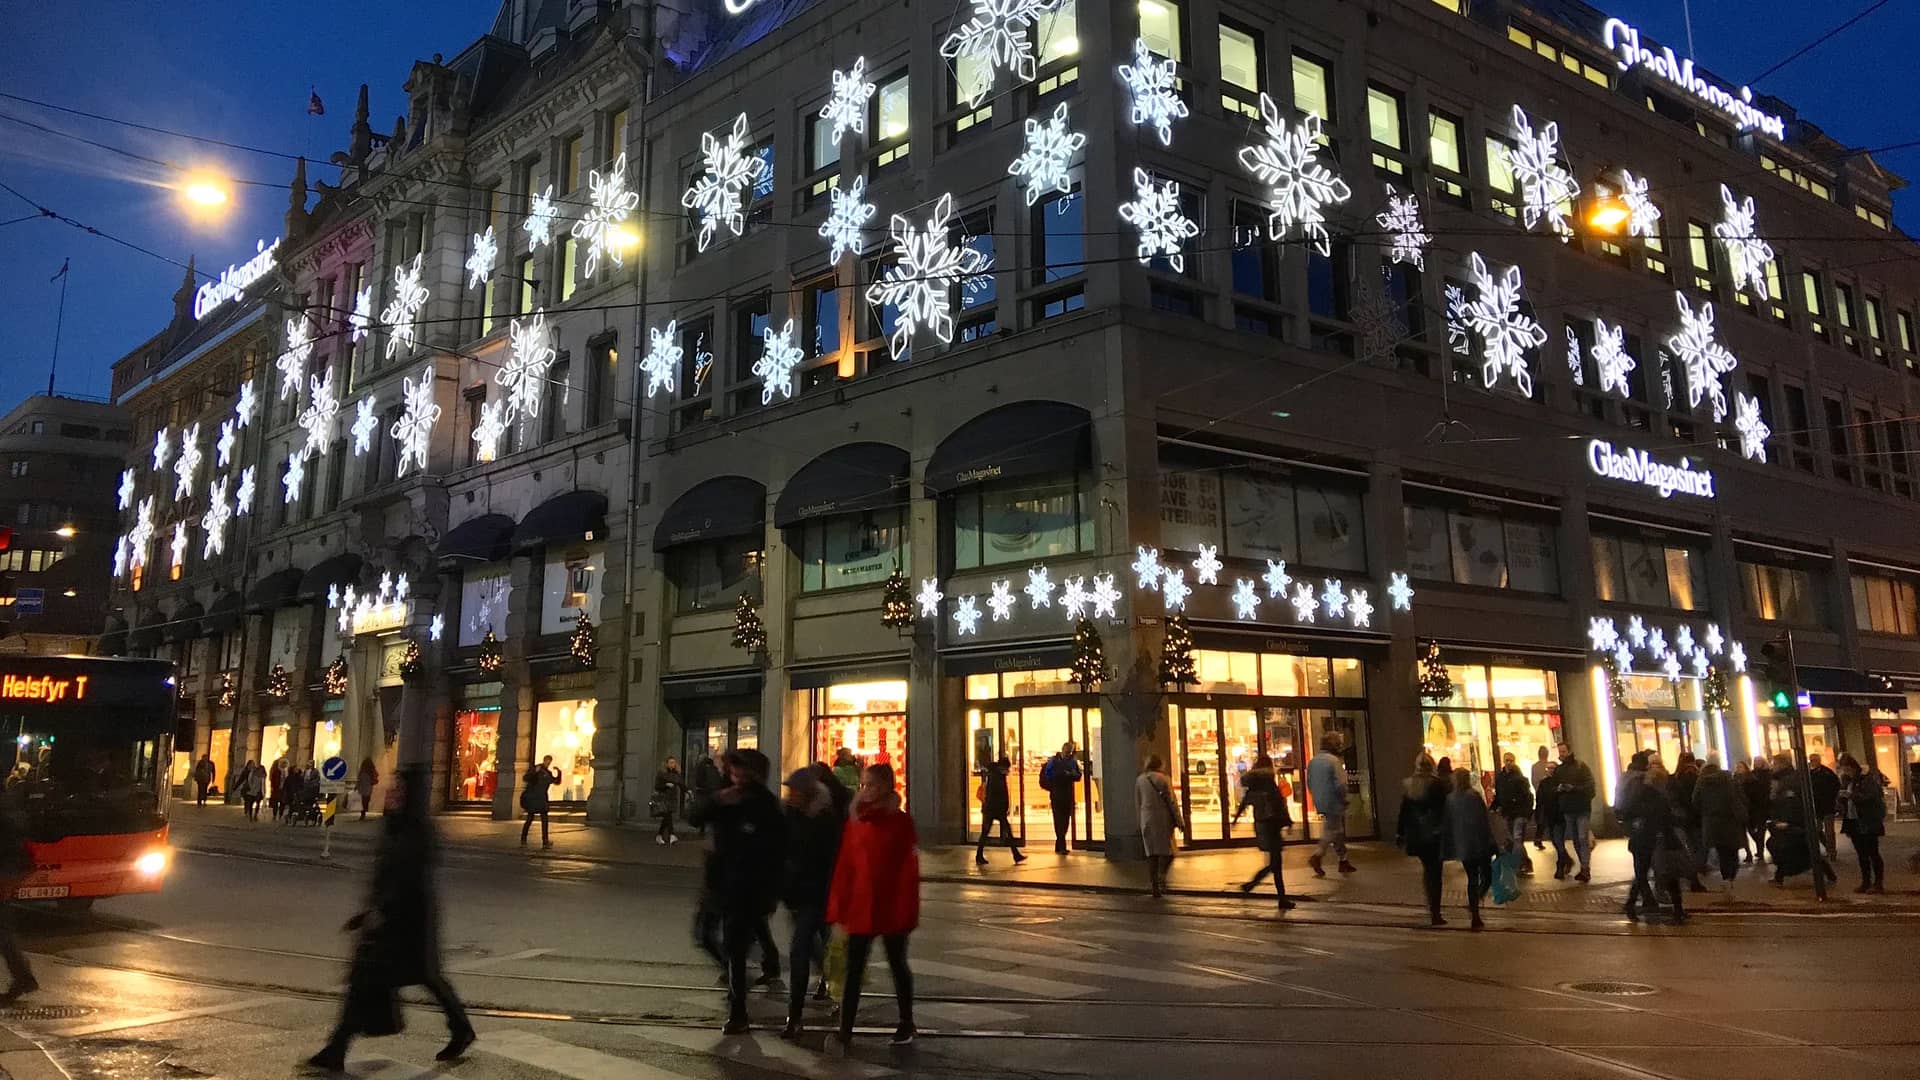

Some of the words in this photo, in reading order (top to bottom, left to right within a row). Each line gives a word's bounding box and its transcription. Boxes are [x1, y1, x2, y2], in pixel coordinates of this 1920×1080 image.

[1604, 17, 1785, 142] GlasMagasinet
[1588, 439, 1715, 498] GlasMagasinet
[1160, 489, 1192, 508] AVE-
[2, 674, 69, 702] Helsfyr
[76, 675, 88, 699] T
